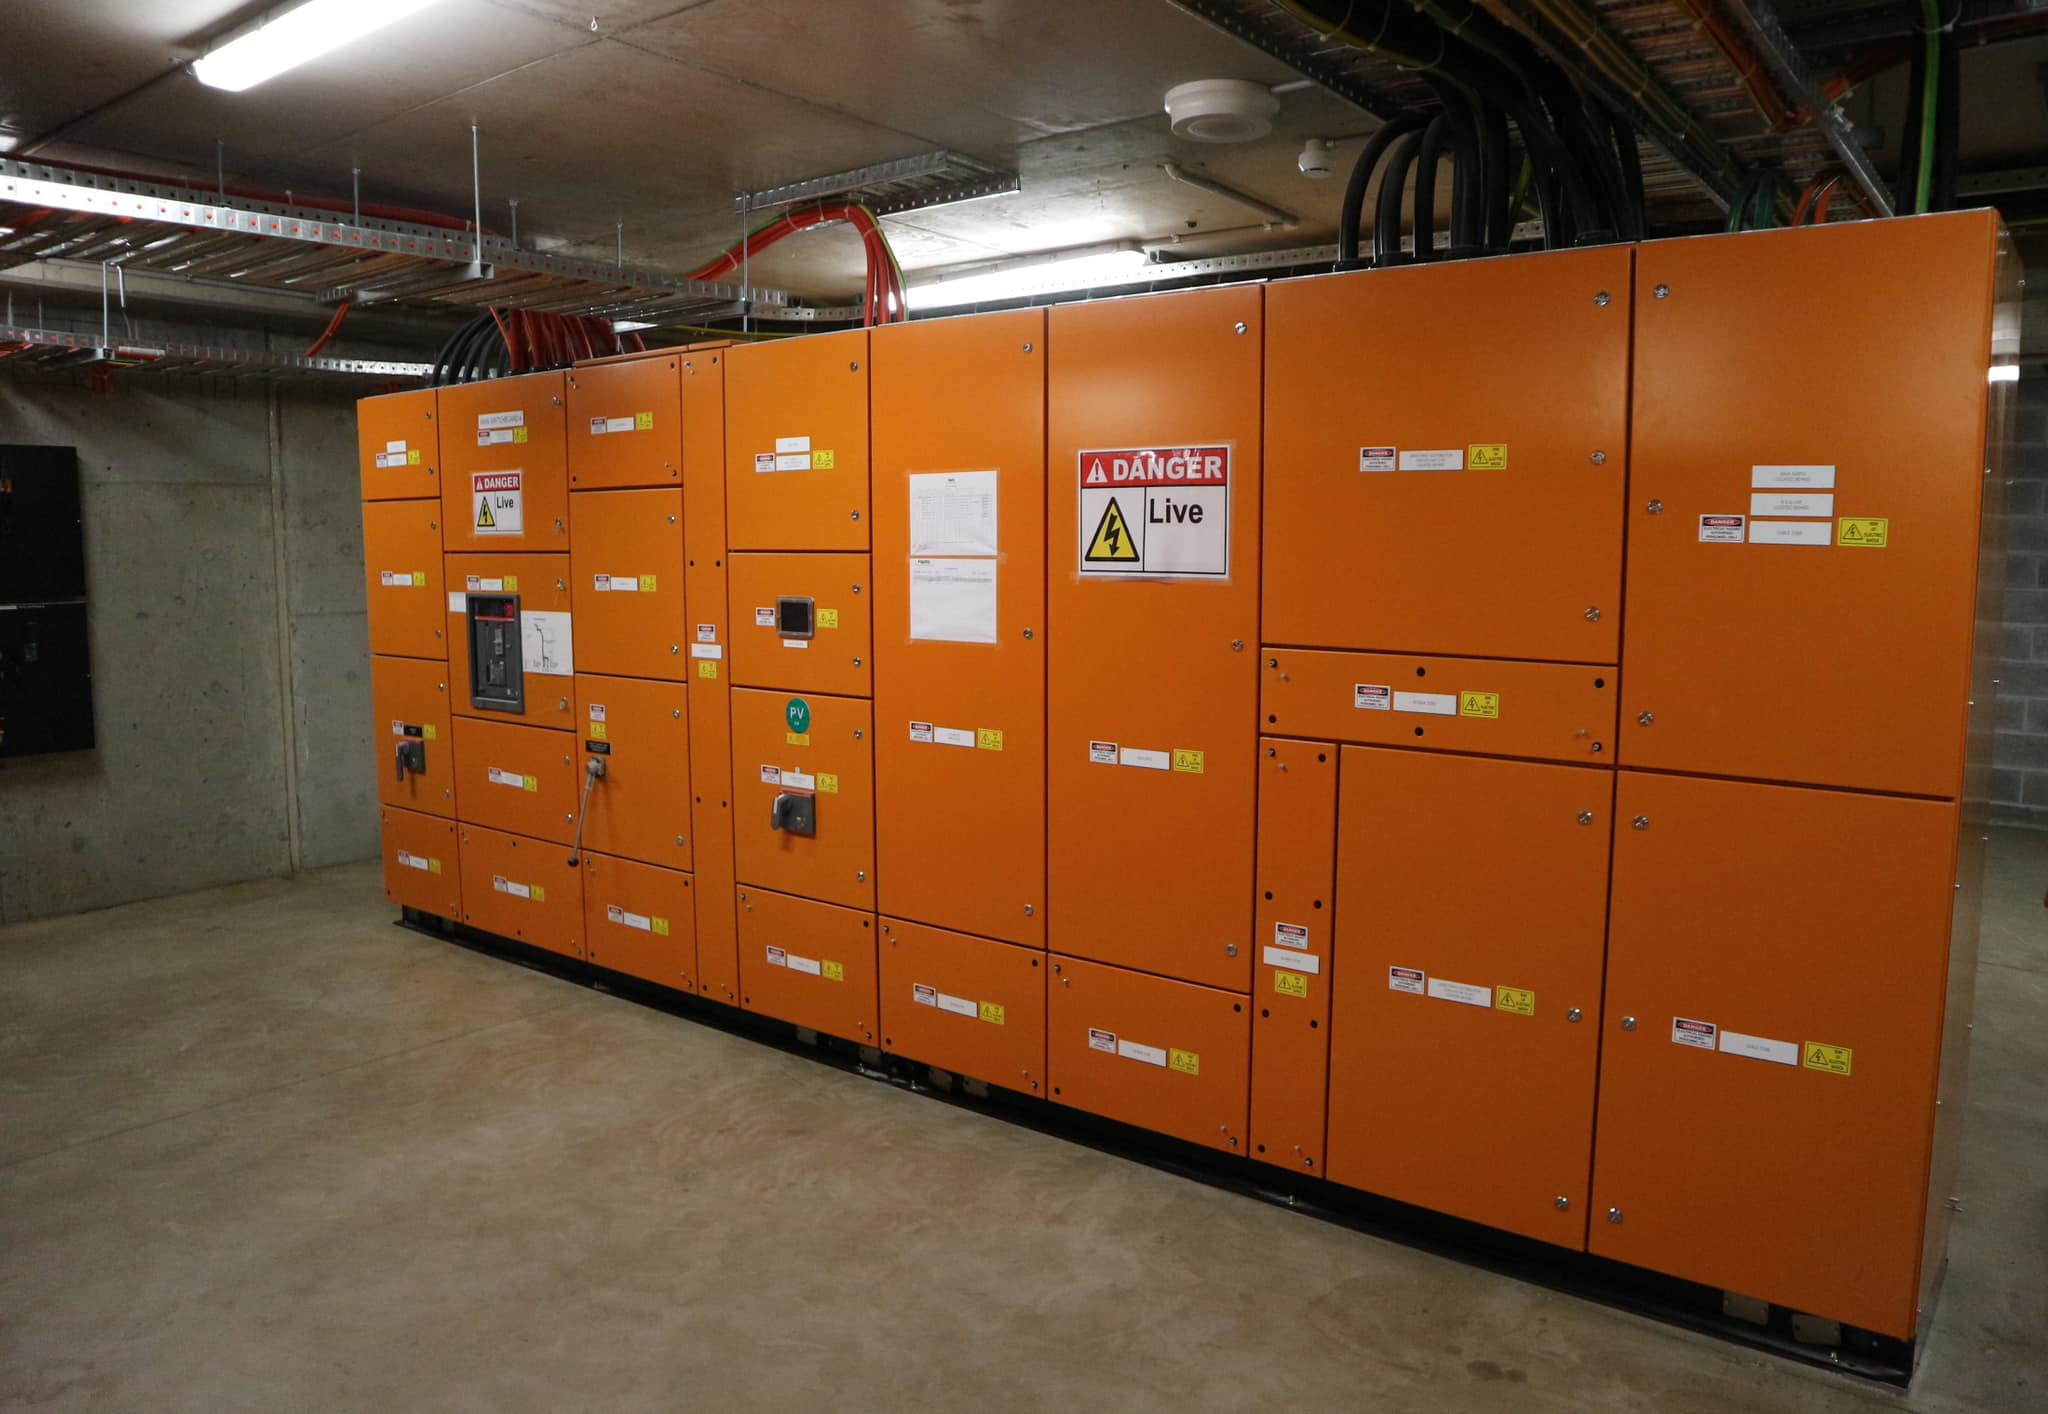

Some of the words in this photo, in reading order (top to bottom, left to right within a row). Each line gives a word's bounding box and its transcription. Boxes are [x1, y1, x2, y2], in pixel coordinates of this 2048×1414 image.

[1113, 456, 1222, 481] DANGER
[484, 476, 519, 489] DANGER
[496, 496, 514, 509] Live
[1150, 498, 1203, 523] Live
[790, 706, 804, 719] PV
